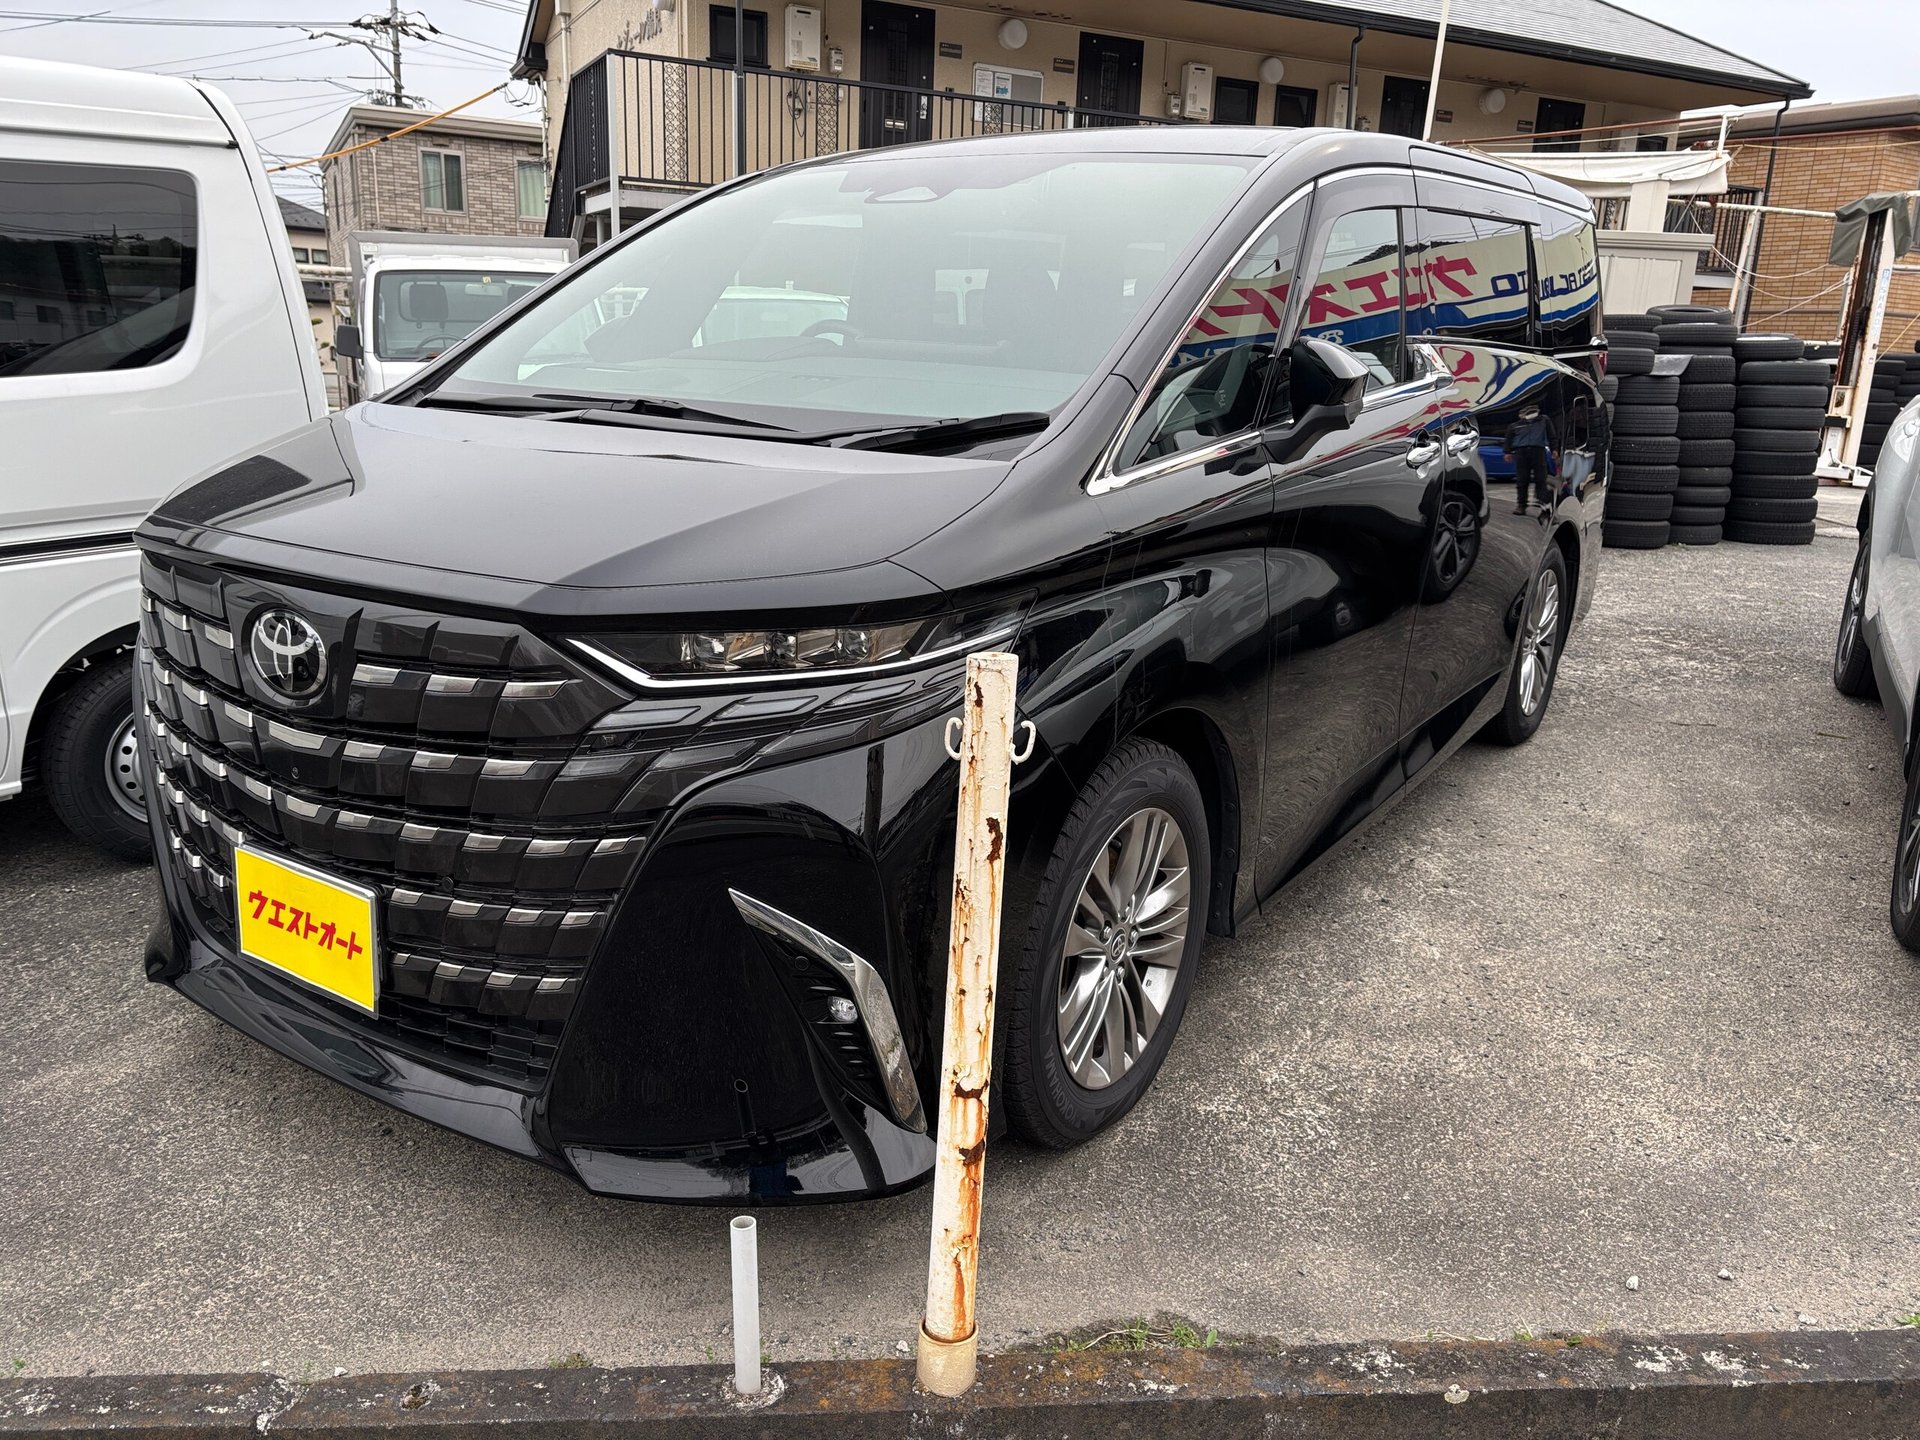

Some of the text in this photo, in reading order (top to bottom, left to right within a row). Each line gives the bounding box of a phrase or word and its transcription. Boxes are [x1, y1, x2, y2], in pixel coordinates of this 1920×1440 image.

[248, 890, 363, 960] ウエストオート
[1044, 1043, 1077, 1126] YOKOHAMA
